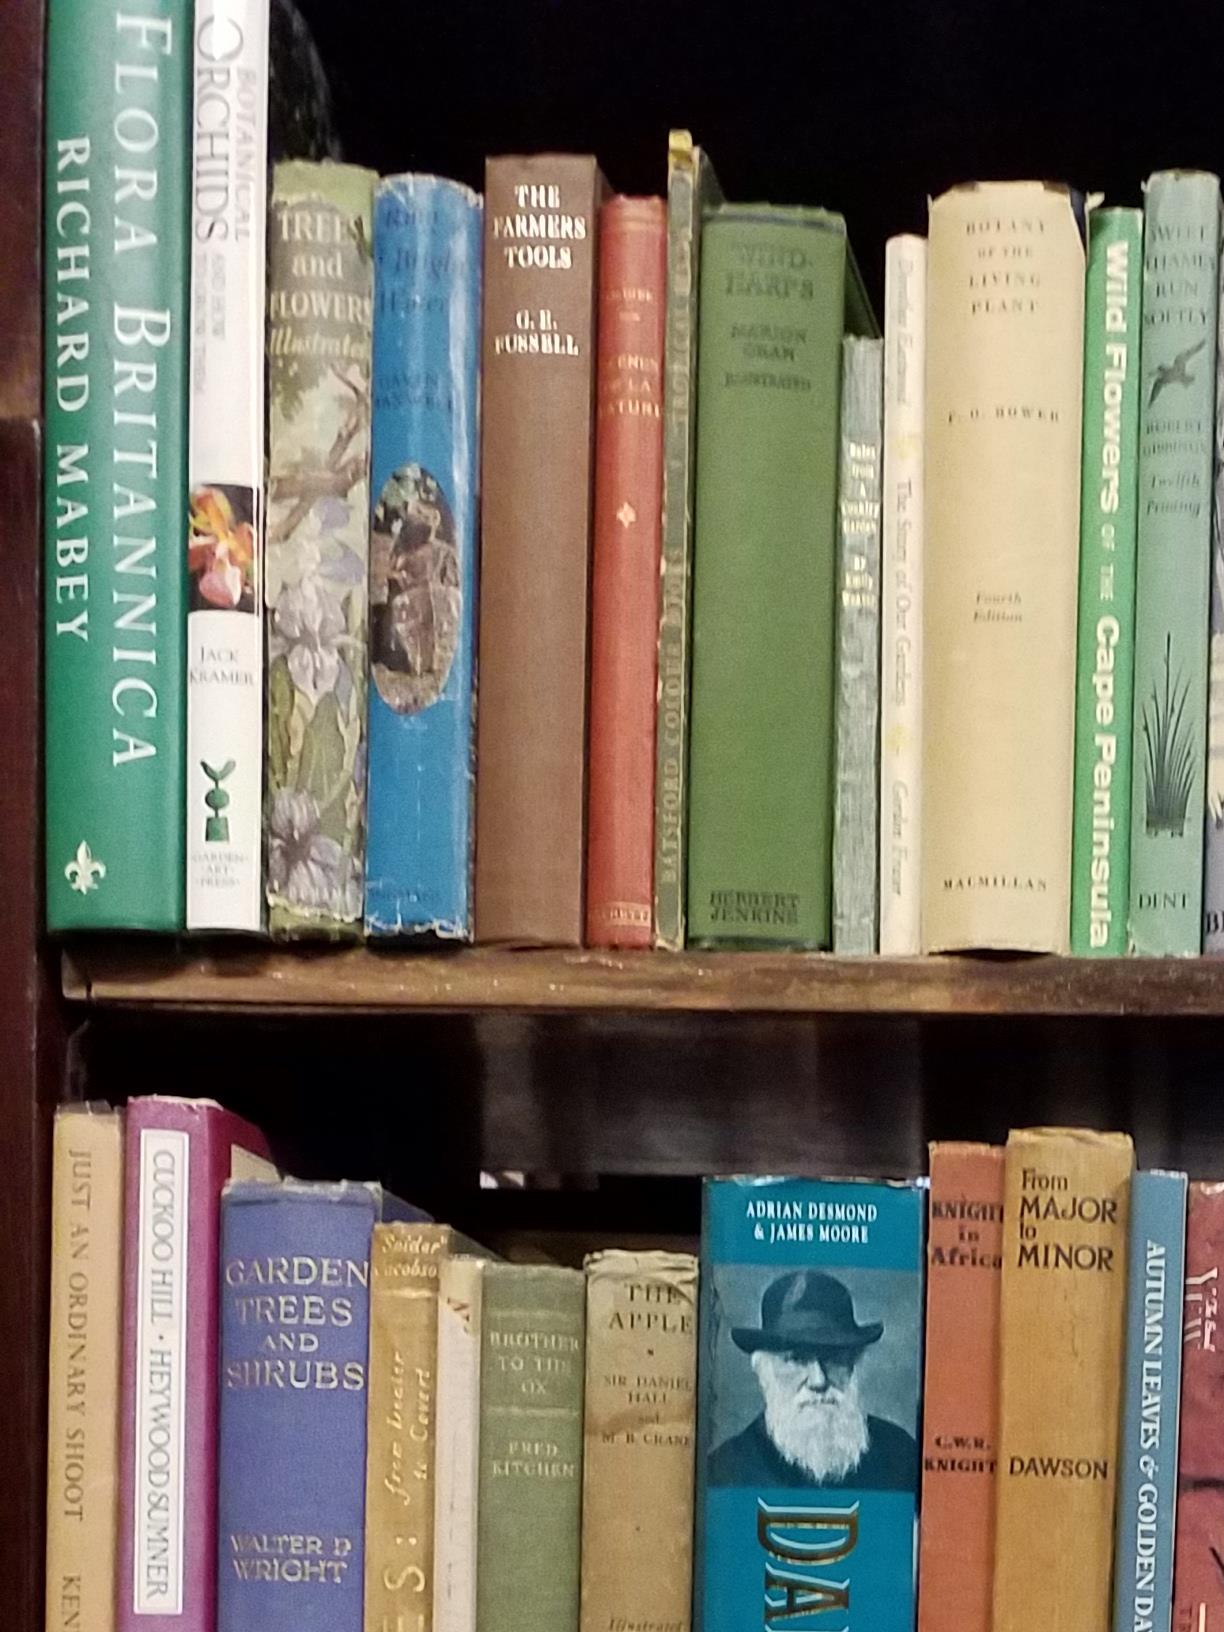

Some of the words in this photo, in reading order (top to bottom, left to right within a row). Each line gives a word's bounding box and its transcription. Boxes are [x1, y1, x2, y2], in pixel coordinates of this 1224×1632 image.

[114, 11, 172, 254] FLORA
[195, 14, 244, 243] ORCHIDS
[515, 185, 561, 209] THE
[505, 246, 572, 269] TOOLS
[56, 135, 91, 413] RICHARD
[1104, 241, 1128, 332] Wild
[1100, 341, 1126, 513] Flowers
[55, 443, 90, 641] MABEY
[112, 304, 171, 768] BRITANNICA
[1100, 566, 1114, 601] THE
[200, 646, 239, 664] JACK
[1096, 616, 1119, 726] Cape
[189, 667, 255, 686] KRAMER
[1089, 735, 1117, 948] Peninsula
[943, 876, 1047, 891] MACMILLAN
[68, 1151, 91, 1212] JUST
[1021, 1170, 1069, 1191] From
[151, 1150, 176, 1262] CUCKOO
[747, 1201, 802, 1219] ADRIAN
[808, 1203, 878, 1222] DESMOND
[1020, 1195, 1118, 1223] MAJOR
[68, 1225, 89, 1260] AN
[770, 1223, 814, 1243] JAMES
[819, 1225, 869, 1243] MOORE
[225, 1257, 369, 1287] GARDEN
[931, 1247, 1002, 1269] Africa
[1016, 1245, 1115, 1272] MINOR
[149, 1267, 174, 1323] HILL
[1143, 1239, 1167, 1356] AUTUMN
[236, 1297, 353, 1327] TREES
[608, 1312, 692, 1334] APPLE
[65, 1274, 88, 1415] ORDINARY
[263, 1333, 320, 1352] AND
[226, 1361, 365, 1390] SHRUBS
[147, 1348, 173, 1491] HEYWOOD
[1139, 1359, 1164, 1451] LEAVES
[62, 1426, 85, 1522] SHOOT
[924, 1457, 997, 1475] KNIGHT
[1009, 1457, 1109, 1480] DAWSON
[1138, 1454, 1155, 1482] &
[146, 1492, 170, 1599] SUMNER
[230, 1535, 323, 1555] WALTER
[1135, 1479, 1159, 1594] GOLDEN
[233, 1559, 348, 1583] WRIGHT
